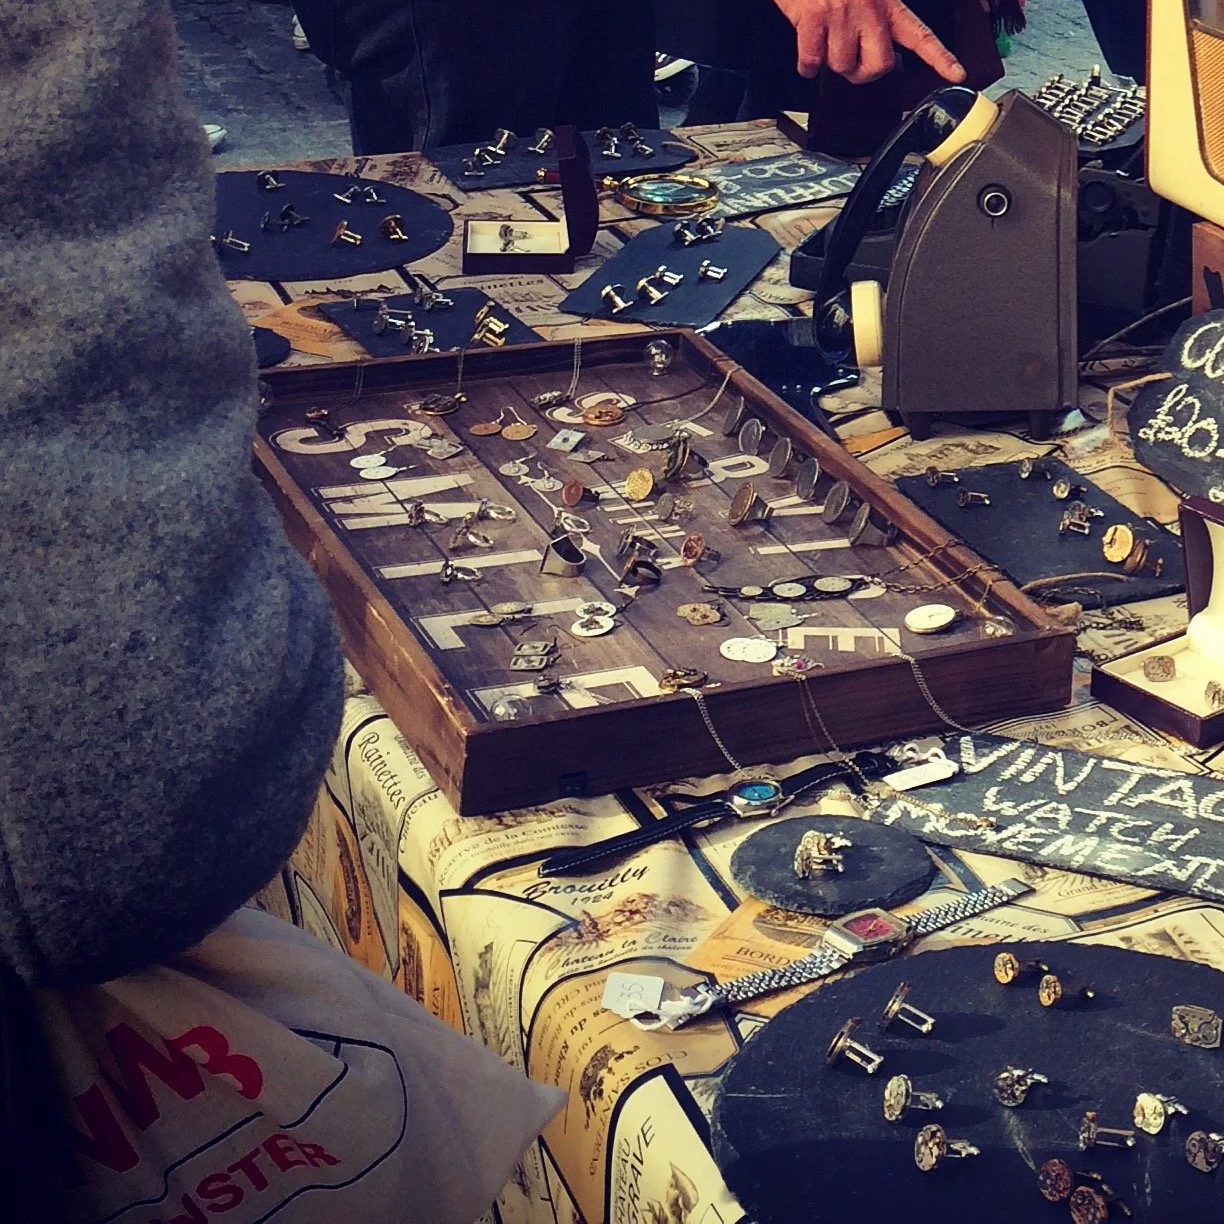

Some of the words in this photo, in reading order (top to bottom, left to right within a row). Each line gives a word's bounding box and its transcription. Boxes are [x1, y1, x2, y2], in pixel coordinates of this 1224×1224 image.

[358, 731, 407, 812] Rainettes
[981, 785, 1200, 852] WATCH
[522, 864, 650, 902] Brouilly
[570, 891, 614, 907] 1924
[621, 938, 638, 949] la
[644, 931, 699, 944] Claire
[570, 1019, 587, 1037] du
[634, 1049, 688, 1073] CLOS
